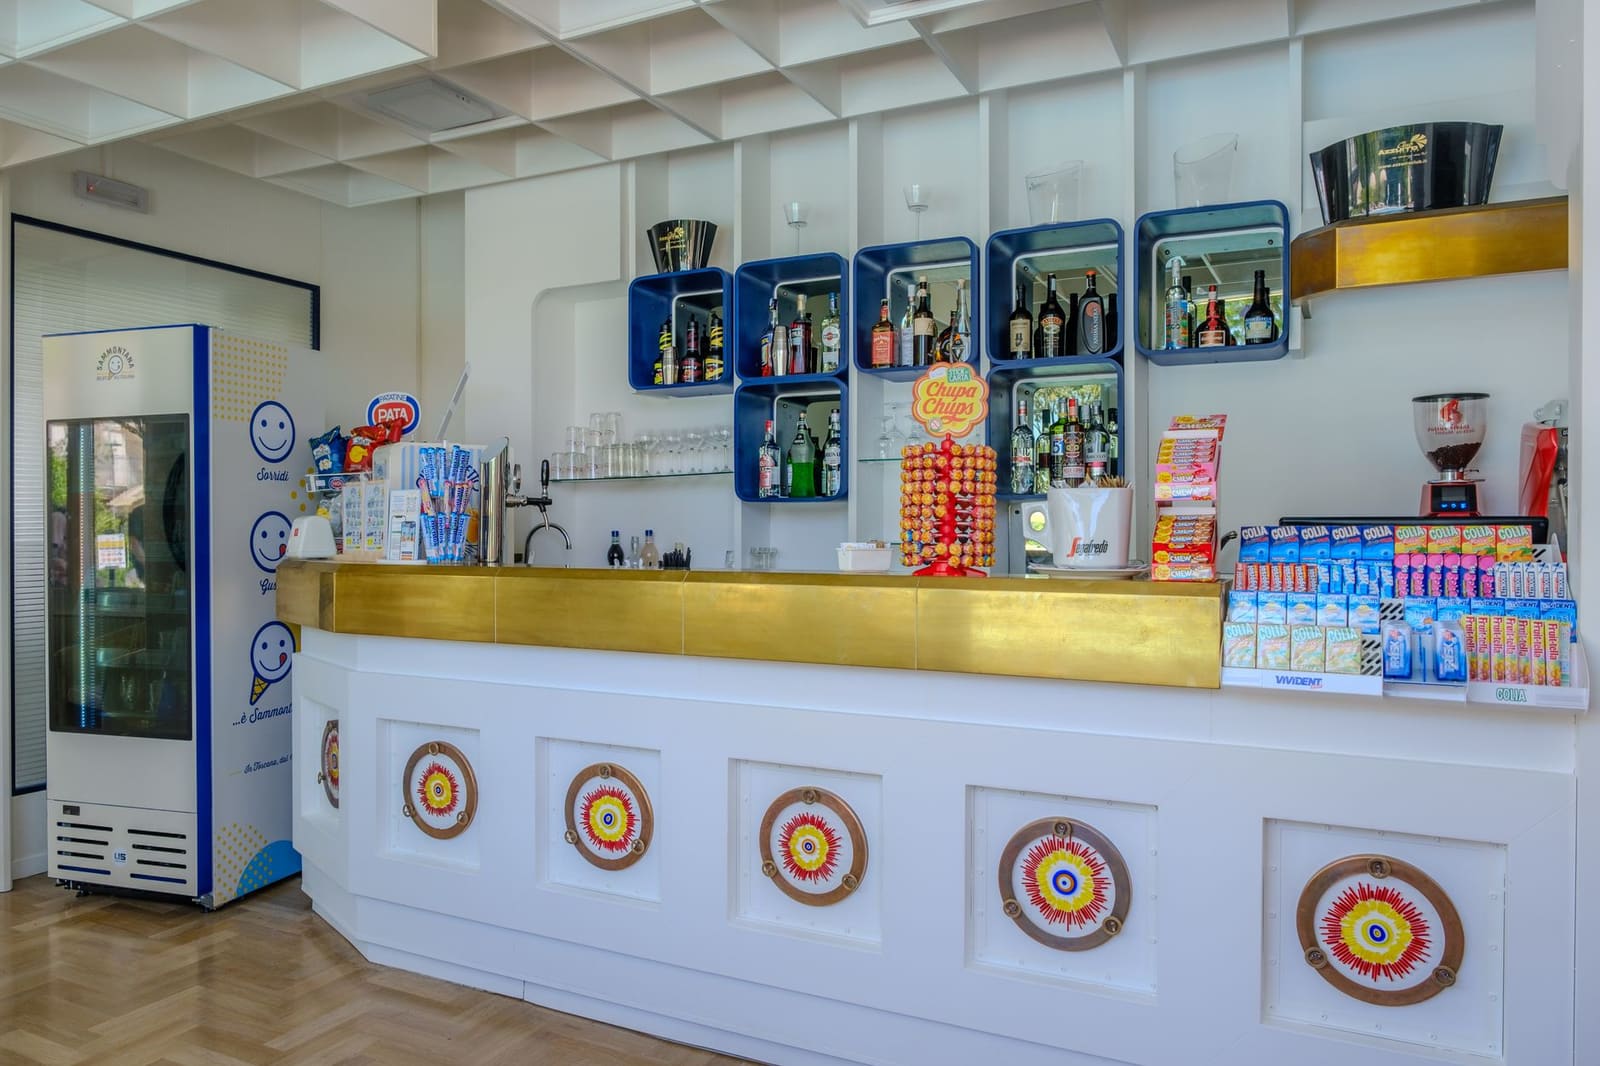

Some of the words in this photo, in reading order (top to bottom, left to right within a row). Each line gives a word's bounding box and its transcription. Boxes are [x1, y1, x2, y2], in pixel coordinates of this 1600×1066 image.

[96, 345, 135, 370] SAMMONTANA
[926, 381, 978, 401] Chupa
[378, 408, 409, 422] PATA
[922, 398, 974, 417] Chups
[257, 467, 289, 481] Sorridi
[1242, 526, 1268, 540] GOLIA
[1271, 526, 1298, 540] GOLIA
[1301, 526, 1329, 540] GOLIA
[1332, 526, 1360, 540] GOLIA
[1363, 526, 1392, 541] GOLIA
[1396, 526, 1425, 540] GOLIA
[1429, 526, 1458, 540] GOLIA
[1463, 526, 1493, 540] GOLIA
[1498, 526, 1529, 540] GOLIA
[1066, 537, 1109, 557] Segafredo
[260, 579, 277, 595] Gus
[1225, 623, 1254, 639] GOLIA
[1258, 624, 1288, 640] GOLIA
[1292, 625, 1323, 642] GOLIA
[1328, 627, 1358, 642] GOLIA
[1275, 675, 1323, 686] VIVIDENT
[1496, 687, 1527, 702] GOLIA
[249, 702, 292, 723] Sammont
